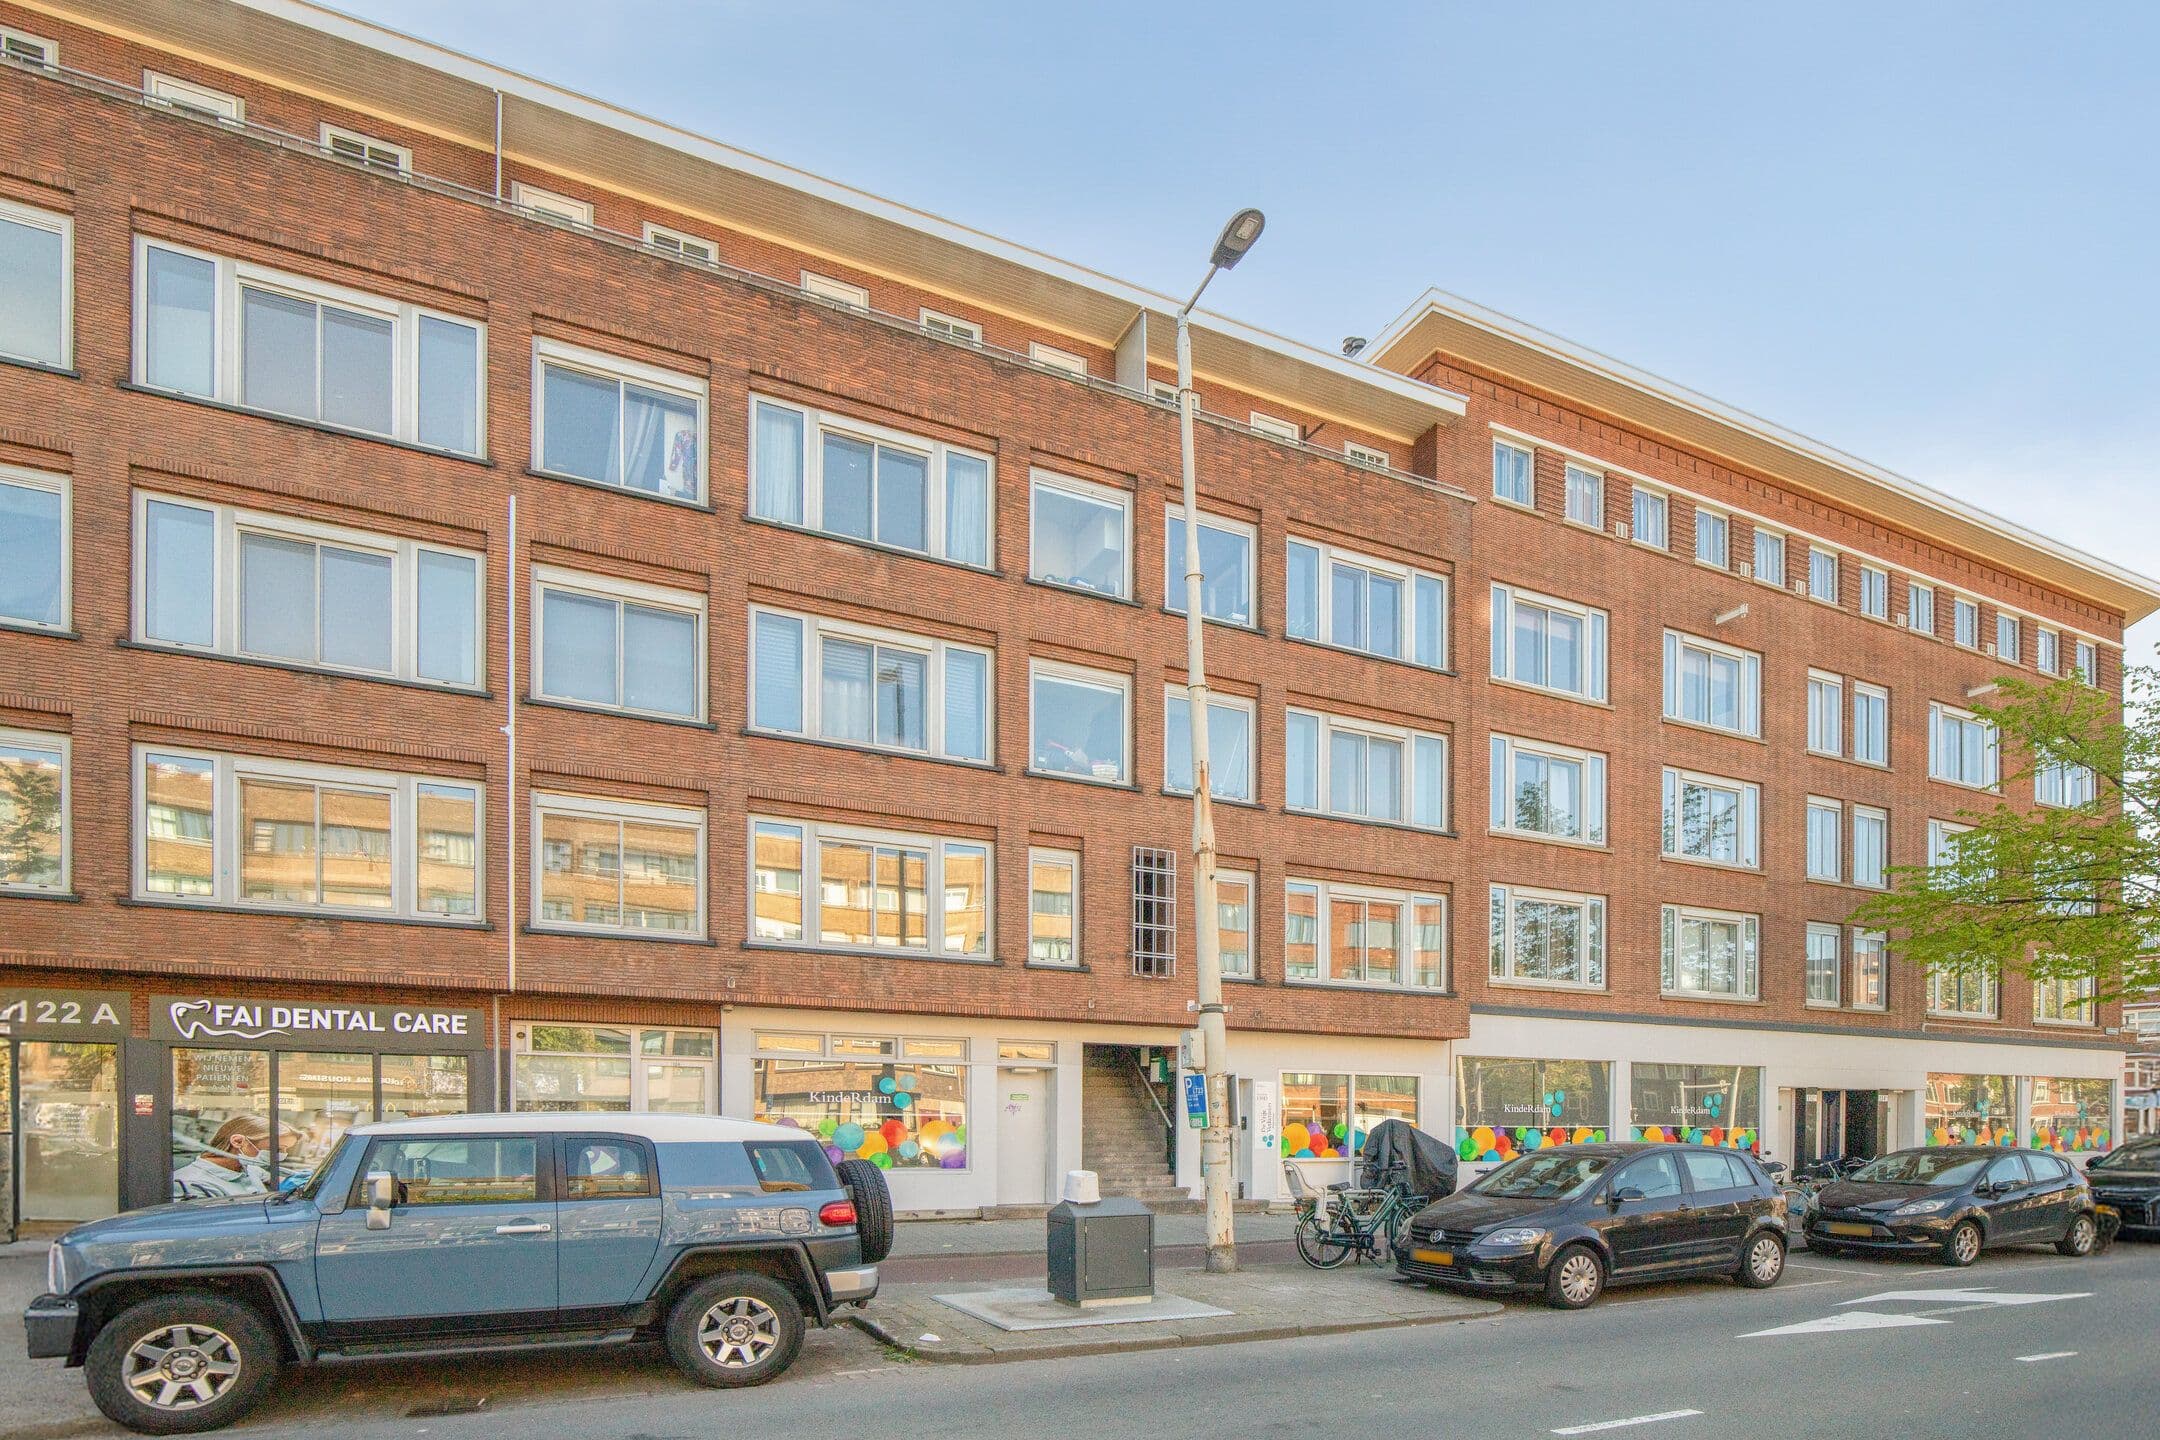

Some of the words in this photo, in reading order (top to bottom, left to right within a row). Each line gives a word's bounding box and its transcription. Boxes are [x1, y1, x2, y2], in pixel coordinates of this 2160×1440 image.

[92, 1003, 120, 1025] A
[214, 1004, 262, 1027] FAI
[272, 1007, 386, 1032] DENTAL
[393, 1012, 468, 1035] CARE
[214, 1055, 252, 1063] NEMEN
[809, 1091, 892, 1104] KindeRdam
[1504, 1104, 1551, 1113] KindeRdam
